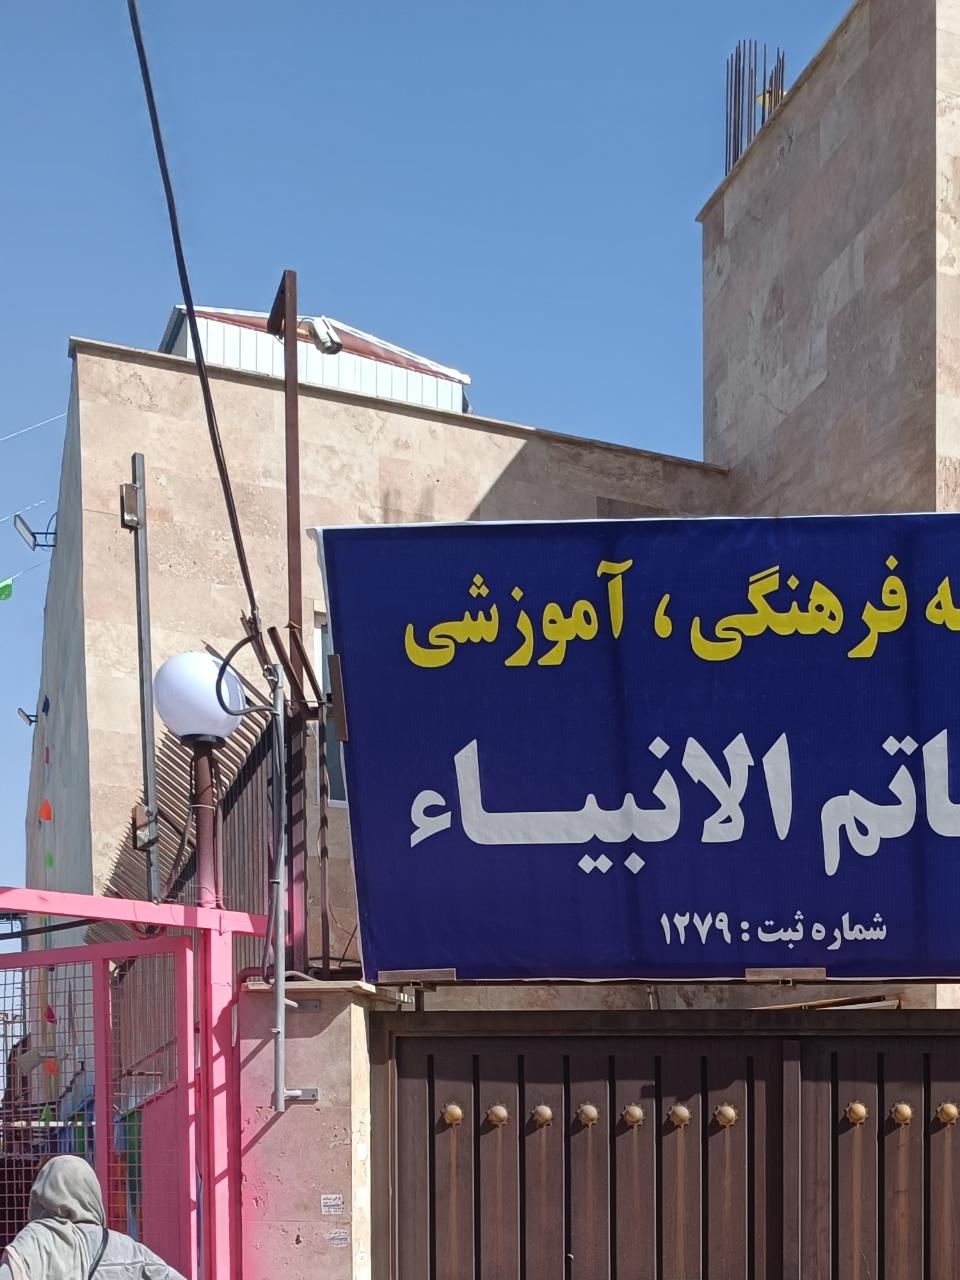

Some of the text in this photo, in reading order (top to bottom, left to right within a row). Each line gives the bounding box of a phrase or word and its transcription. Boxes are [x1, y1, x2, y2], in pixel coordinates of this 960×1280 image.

[404, 559, 633, 668] آموزشی
[410, 732, 793, 874] الانبیاء
[660, 911, 732, 945] ۱۲۷۹
[811, 910, 887, 950] شماره
